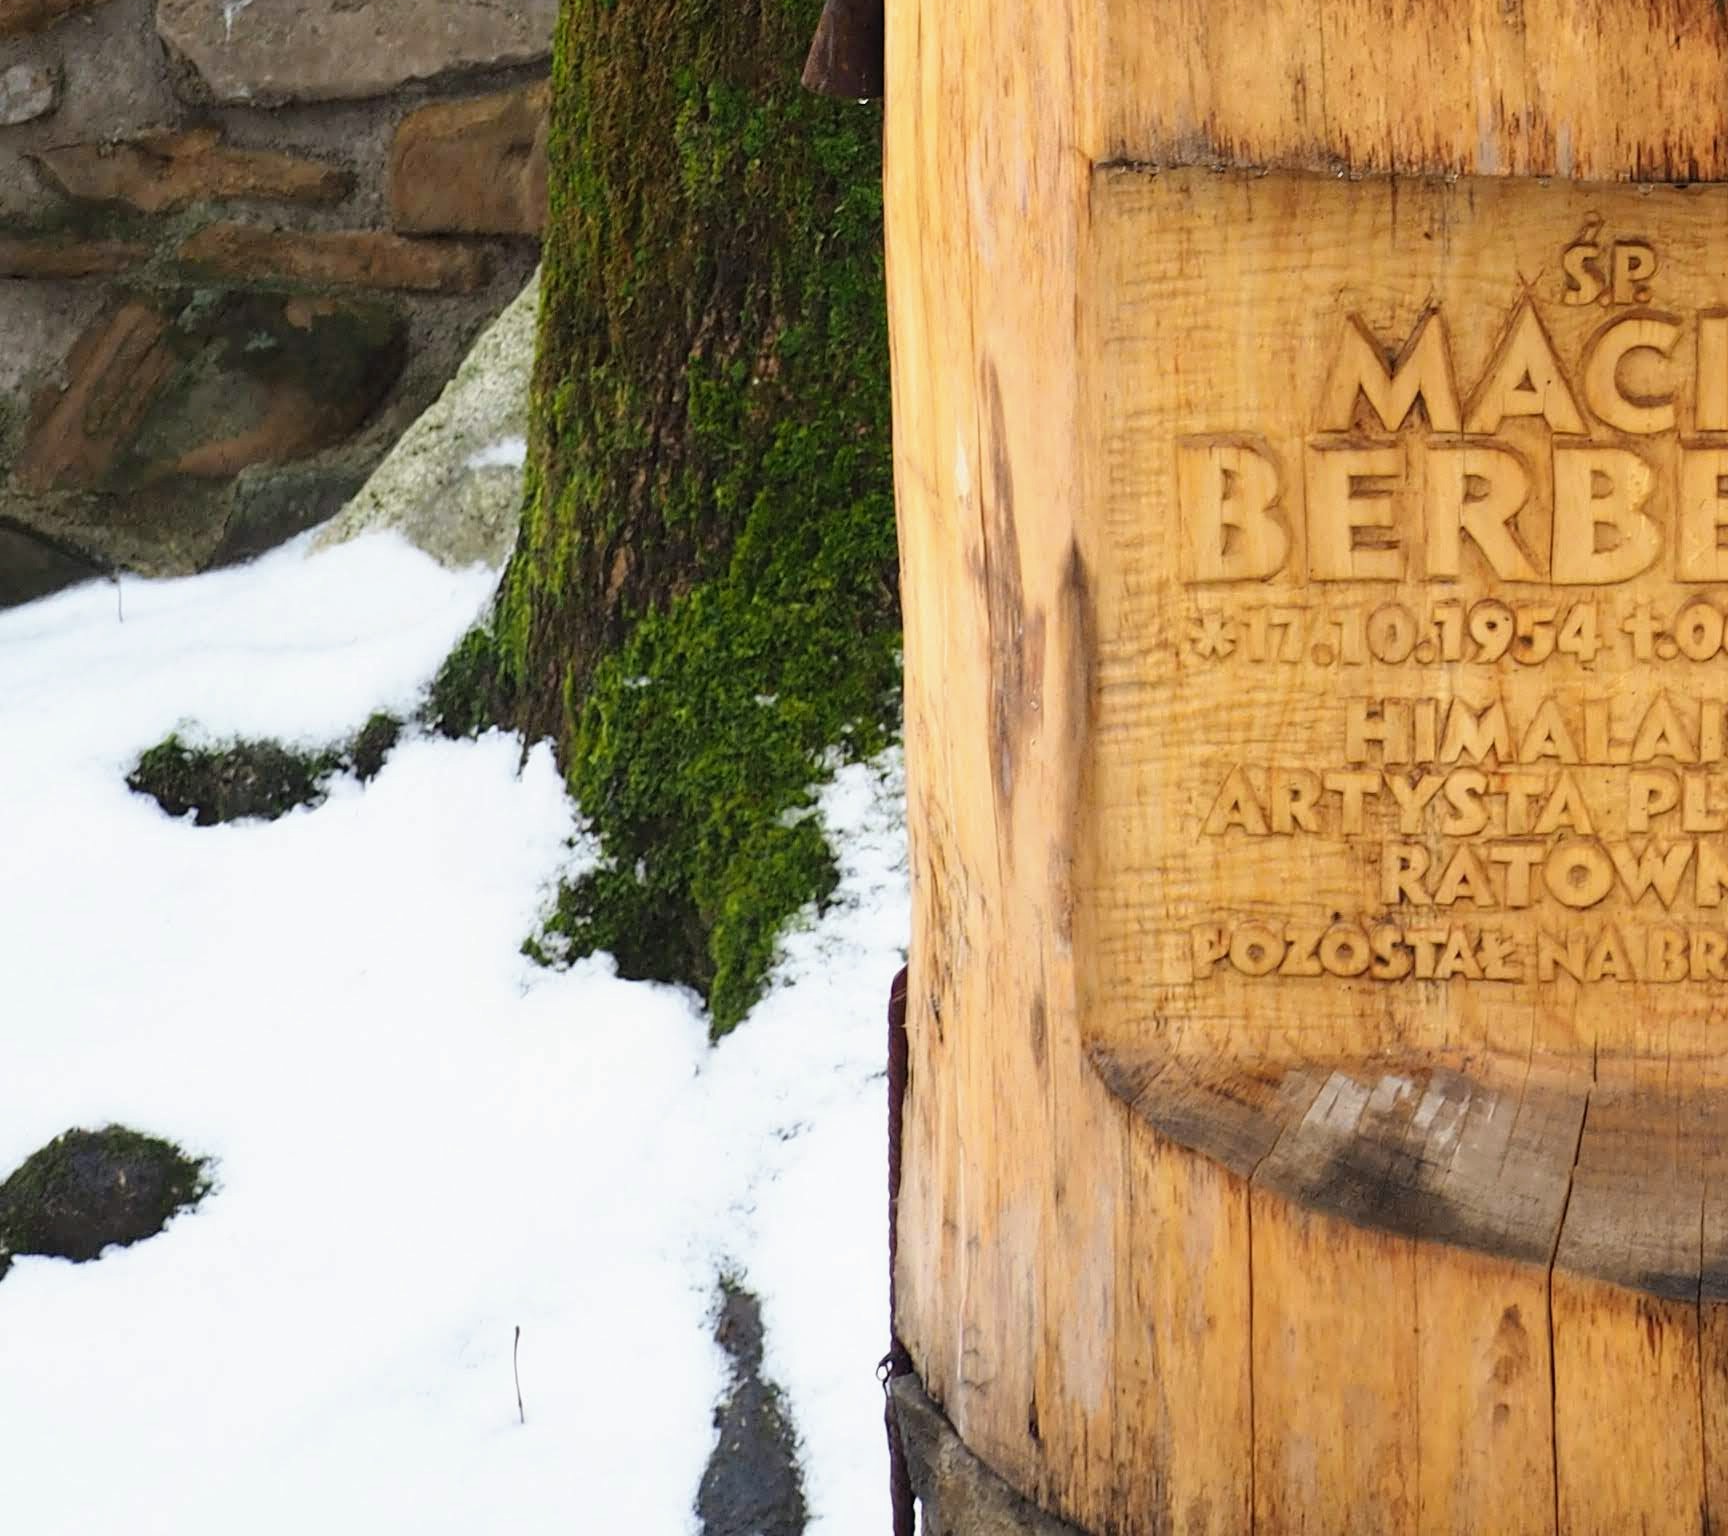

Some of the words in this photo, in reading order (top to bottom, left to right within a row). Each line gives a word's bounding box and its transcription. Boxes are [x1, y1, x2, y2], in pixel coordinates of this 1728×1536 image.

[1204, 764, 1594, 837] ARTYSTA
[1192, 924, 1522, 982] POZOSTAŁ
[1538, 928, 1634, 984] NA
